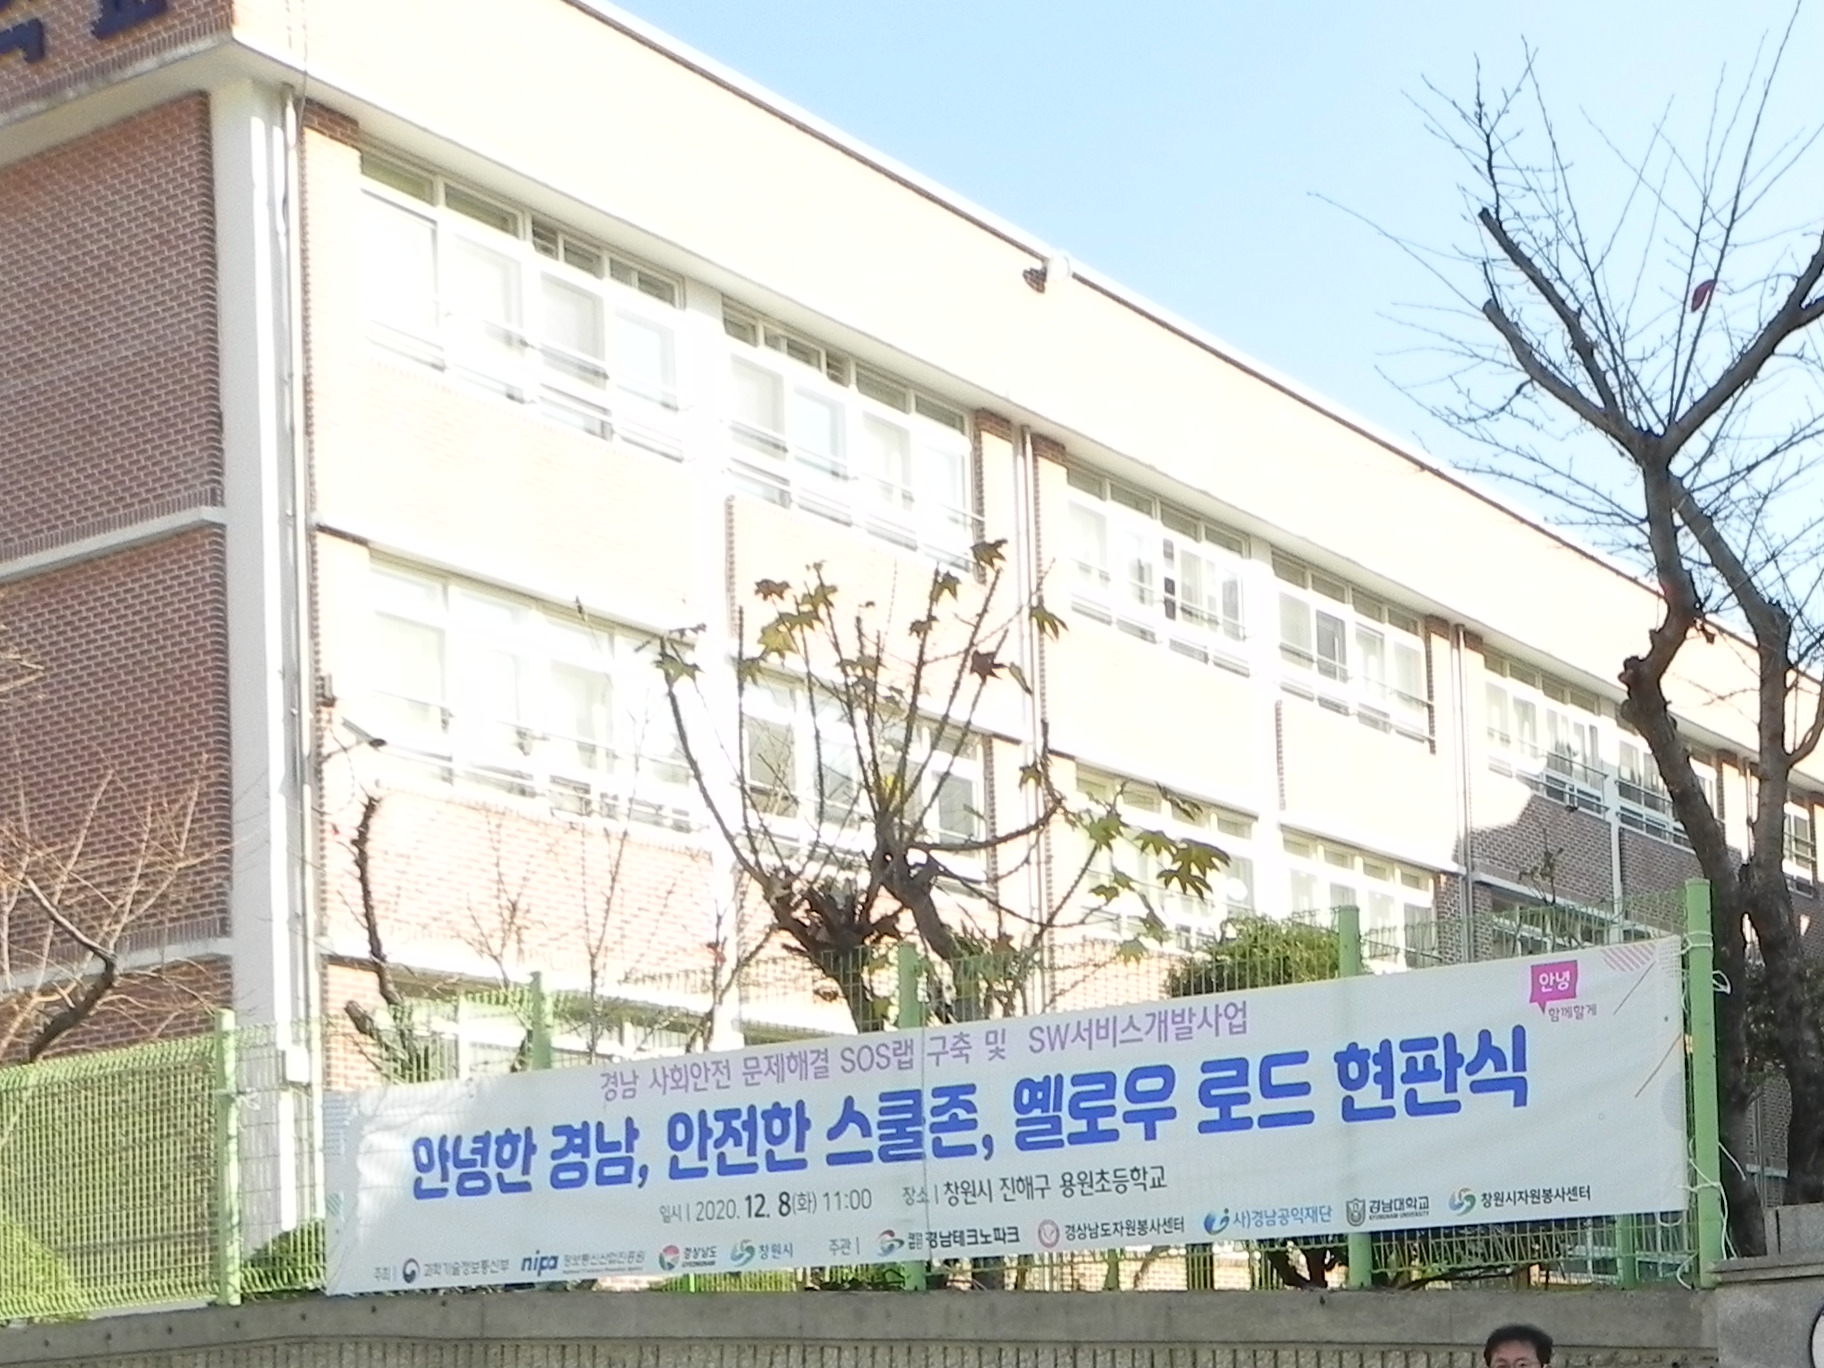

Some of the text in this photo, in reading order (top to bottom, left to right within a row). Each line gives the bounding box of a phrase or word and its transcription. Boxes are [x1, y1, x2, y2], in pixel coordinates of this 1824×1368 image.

[1539, 970, 1570, 993] 안녕
[601, 1000, 1247, 1101] 경남 사회안전 문제해결 SOS랩 구축 및 SW서비스개발사업
[412, 1024, 1528, 1200] 안녕한 경남, 안전한 스쿨존, 옐로우 로드 현판식
[902, 1165, 1167, 1207] 장소 창원시 진해구 용원초등학교
[1481, 1185, 1591, 1208] 창원시자원봉사센터
[659, 1203, 683, 1223] 일시
[695, 1199, 740, 1222] 2020.
[745, 1193, 771, 1219] 12.
[823, 1188, 872, 1212] 11:00
[1369, 1196, 1429, 1214] 경남대학교
[925, 1226, 1020, 1249] 경남테크노파크
[1065, 1216, 1185, 1241] 경상남도자원봉사센터
[759, 1242, 794, 1260] 창원시
[828, 1238, 852, 1256] 주관
[521, 1249, 559, 1277] nipa
